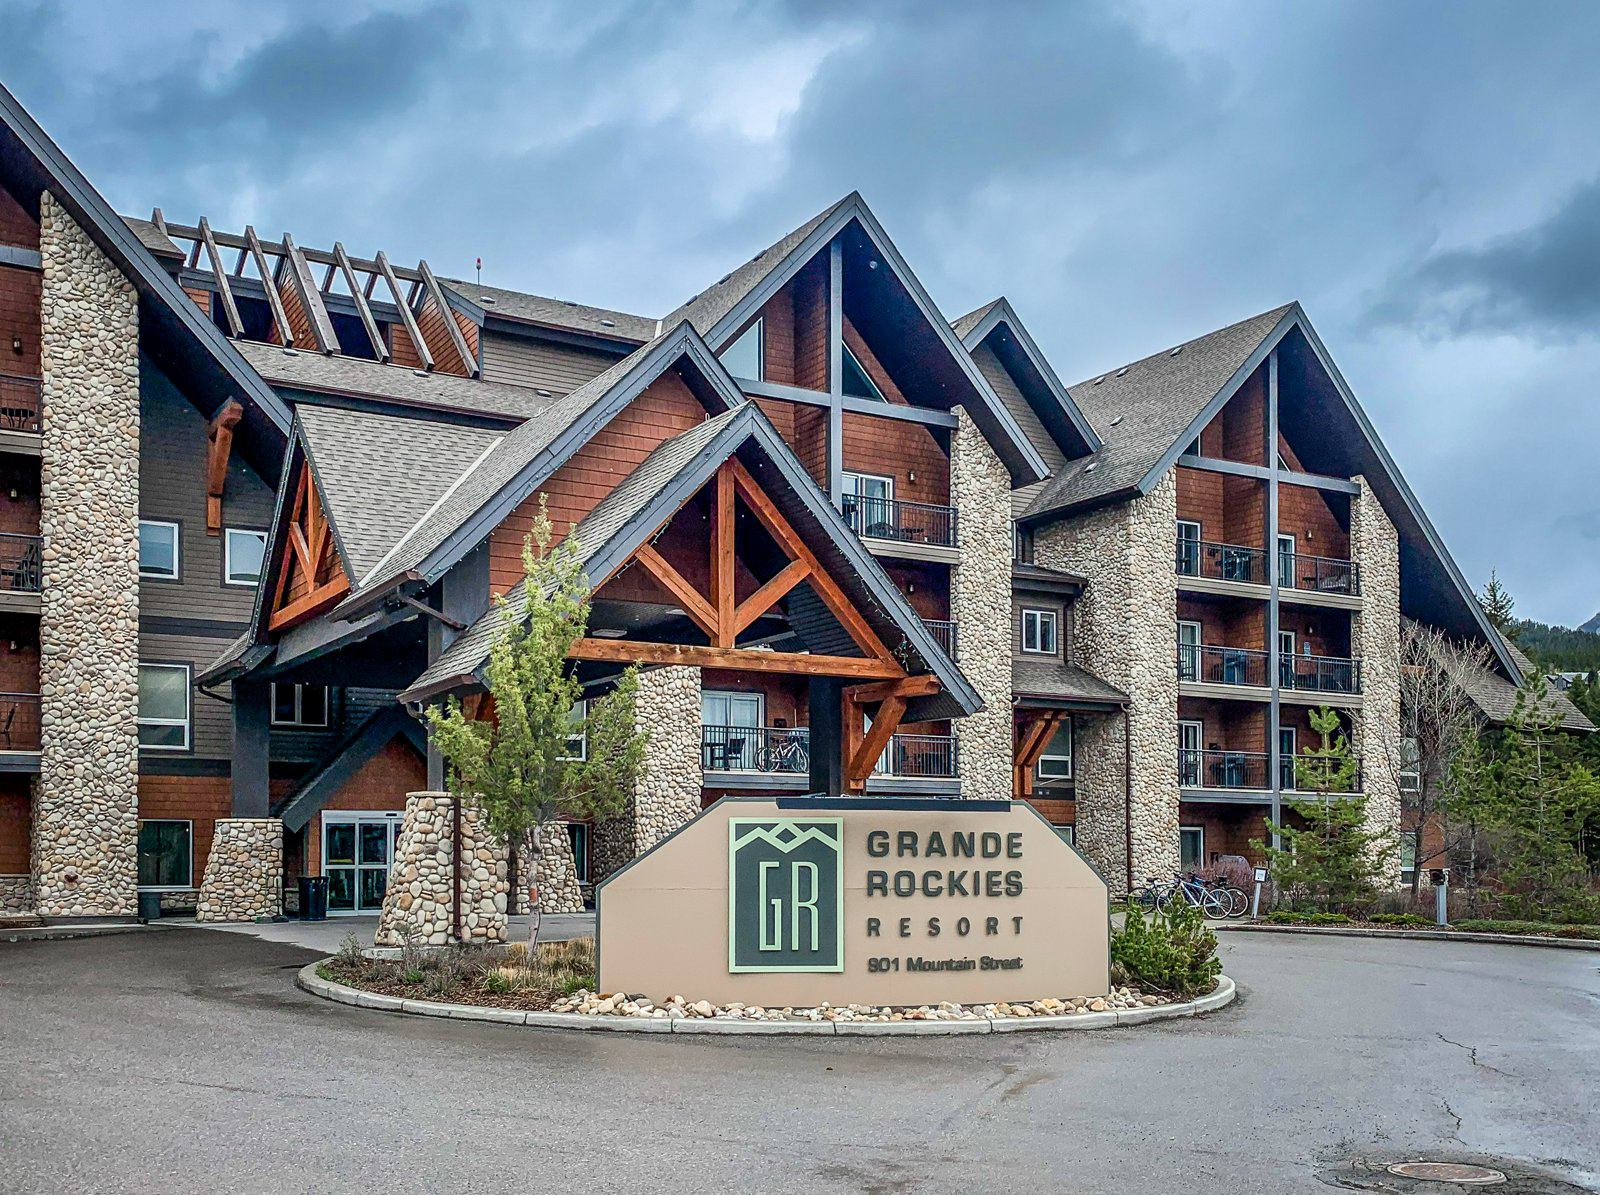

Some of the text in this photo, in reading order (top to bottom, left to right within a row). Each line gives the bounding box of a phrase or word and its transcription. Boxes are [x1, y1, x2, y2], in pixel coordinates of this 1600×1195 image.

[867, 831, 1023, 858] GRANDE
[867, 870, 1023, 897] ROCKIES
[759, 861, 819, 951] GR
[867, 917, 1023, 937] RESORT
[907, 957, 976, 971] Mountain
[980, 956, 1023, 970] Street
